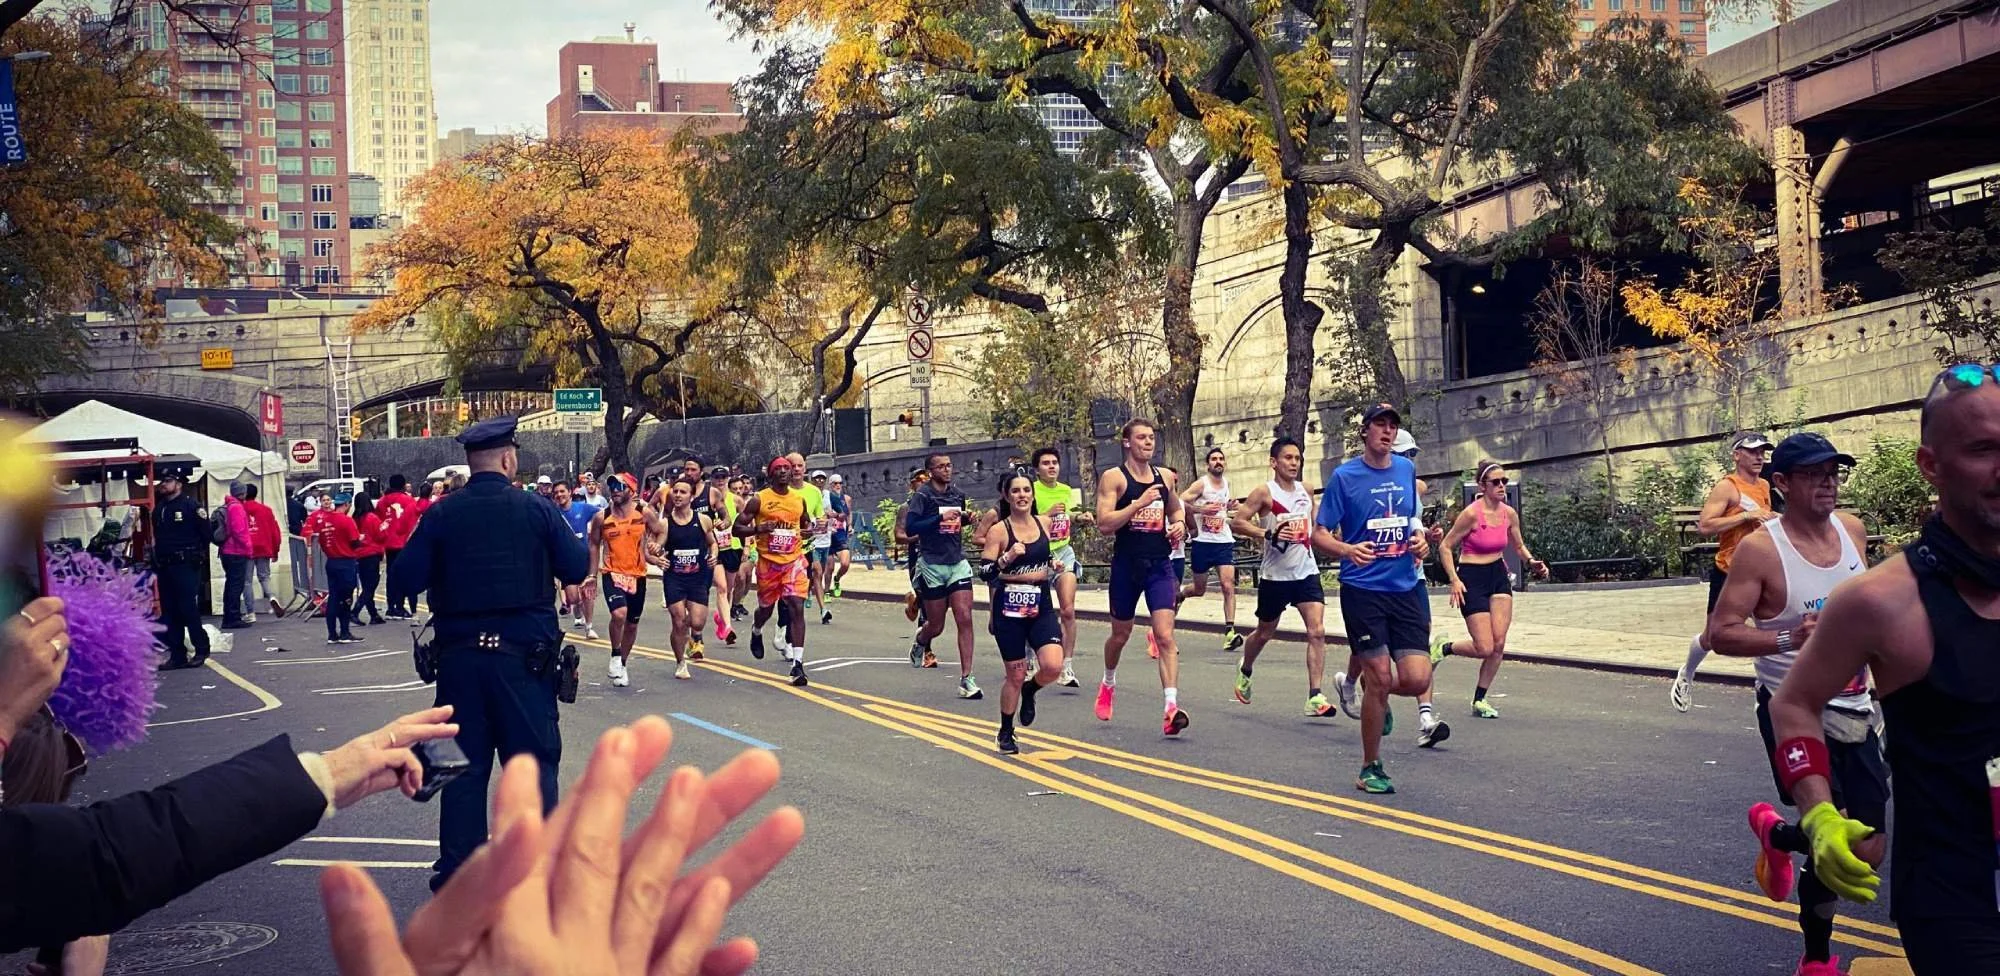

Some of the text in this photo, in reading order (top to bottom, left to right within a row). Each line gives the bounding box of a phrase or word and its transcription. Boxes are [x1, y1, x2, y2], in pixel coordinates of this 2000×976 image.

[0, 103, 21, 160] ROUTE
[916, 366, 925, 374] NO
[911, 376, 929, 384] BUSES
[560, 392, 584, 400] Ed Koch
[556, 402, 592, 410] Queensboro
[1375, 527, 1404, 543] 7716
[676, 555, 697, 564] 3694
[1008, 591, 1036, 605] 8083
